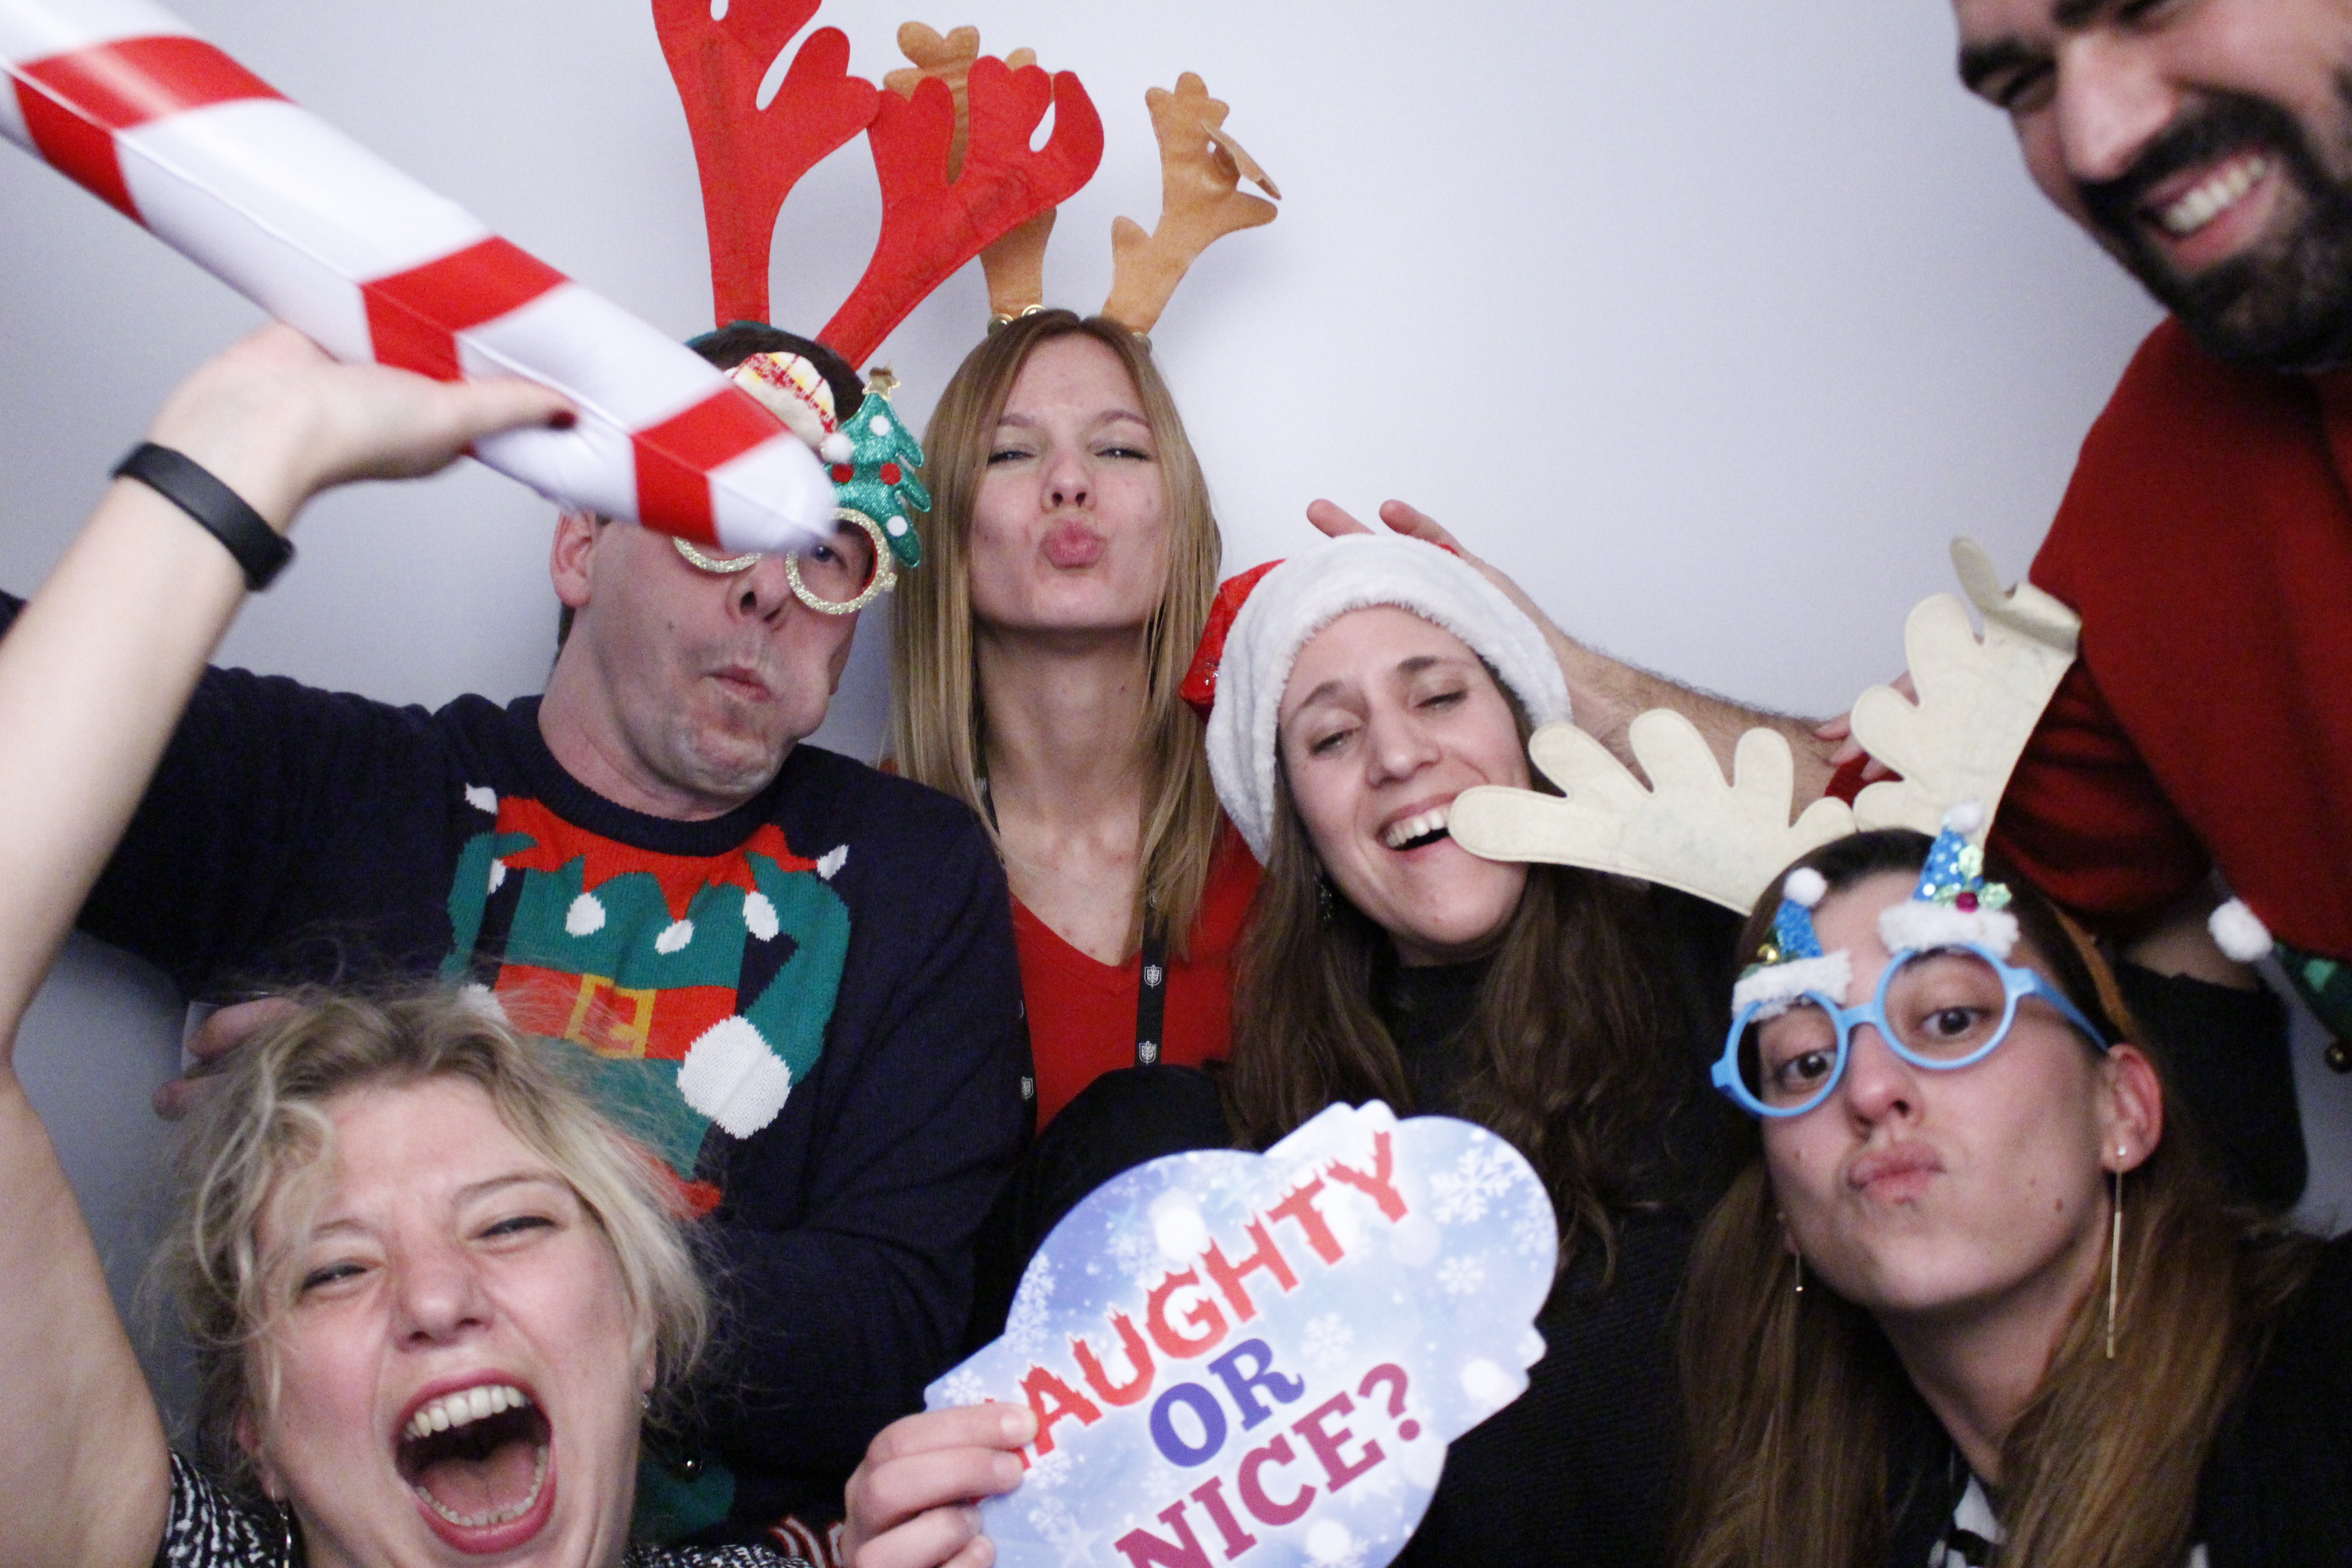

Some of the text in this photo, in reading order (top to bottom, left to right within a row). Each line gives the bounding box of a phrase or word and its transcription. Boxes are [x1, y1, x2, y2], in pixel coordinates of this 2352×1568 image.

[972, 1130, 1409, 1504] AUGHTY
[1149, 1338, 1305, 1468] OR
[1114, 1362, 1421, 1568] NICE?
